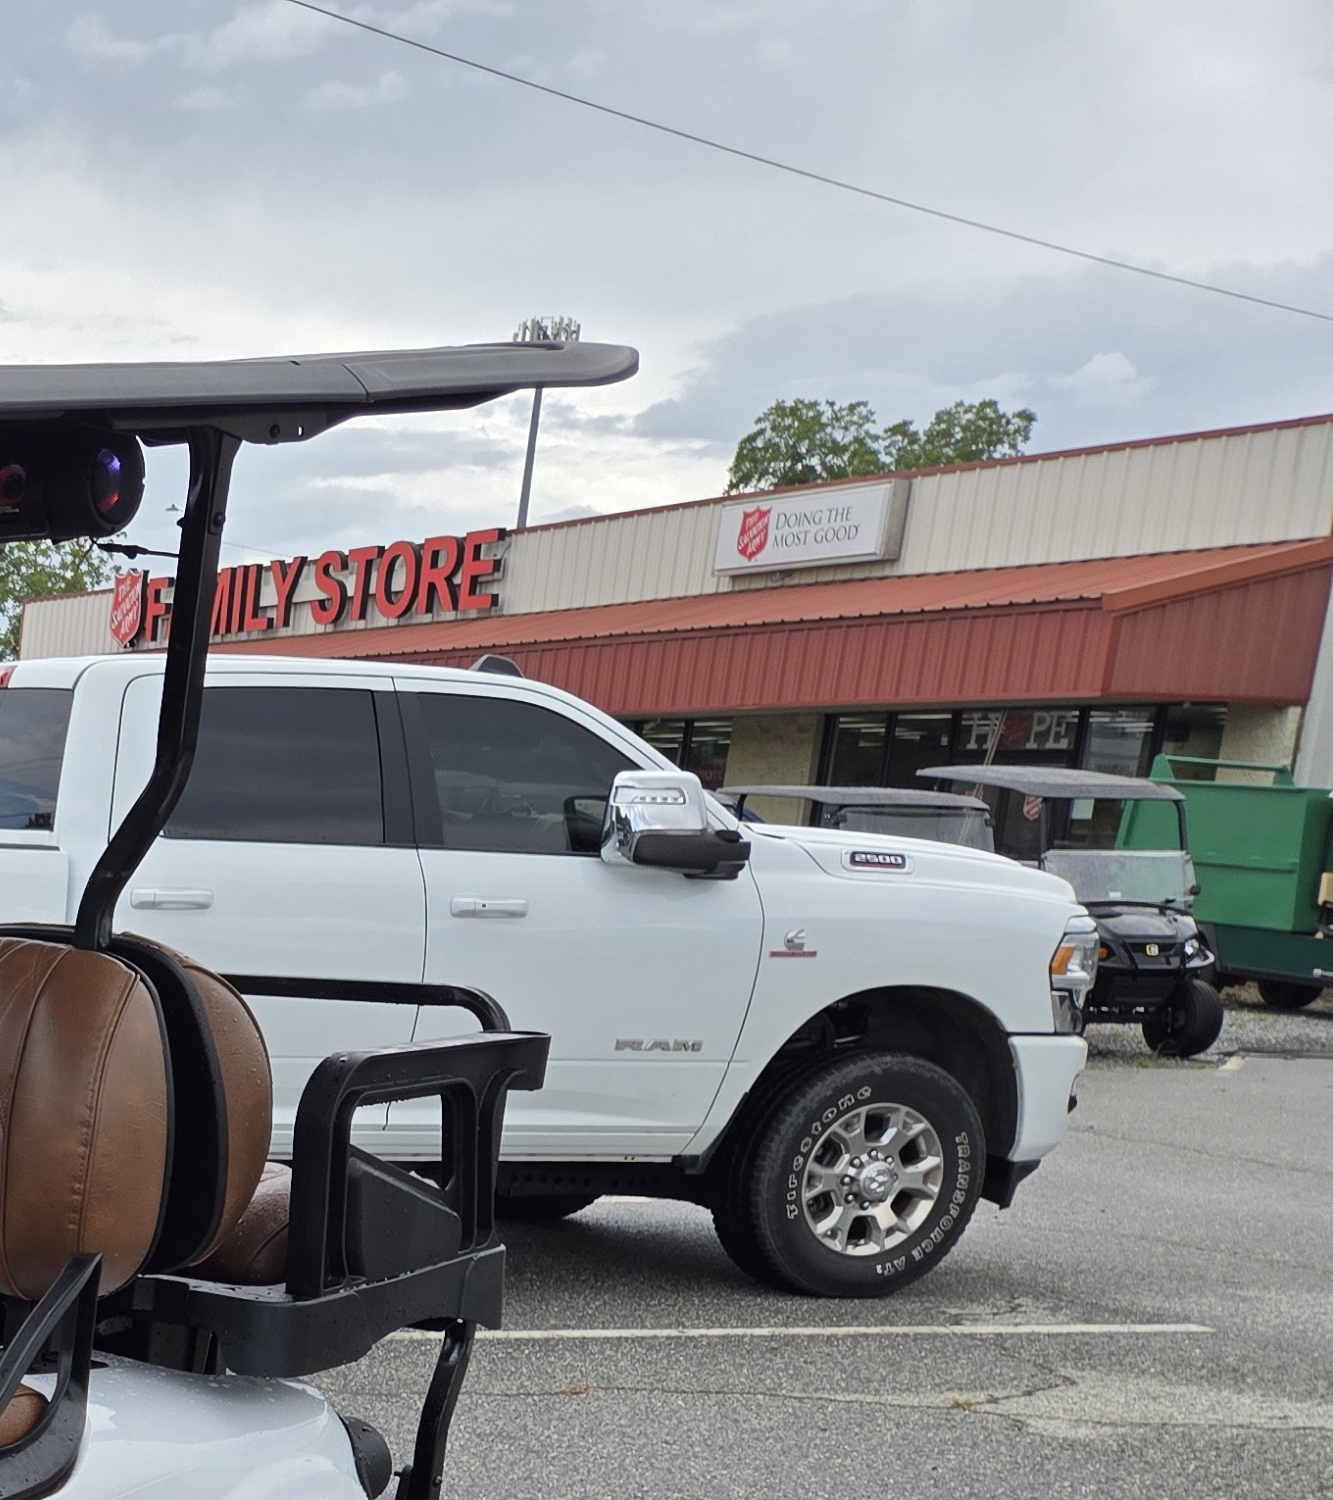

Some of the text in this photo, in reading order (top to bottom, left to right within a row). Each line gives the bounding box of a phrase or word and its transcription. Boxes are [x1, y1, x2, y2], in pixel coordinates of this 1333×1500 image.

[775, 505, 853, 531] DOING THE
[772, 525, 859, 549] MOST GOOD
[145, 527, 505, 643] FMILY STORE
[966, 710, 1070, 750] HPE
[854, 853, 903, 865] 2500
[614, 1038, 704, 1052] RAM
